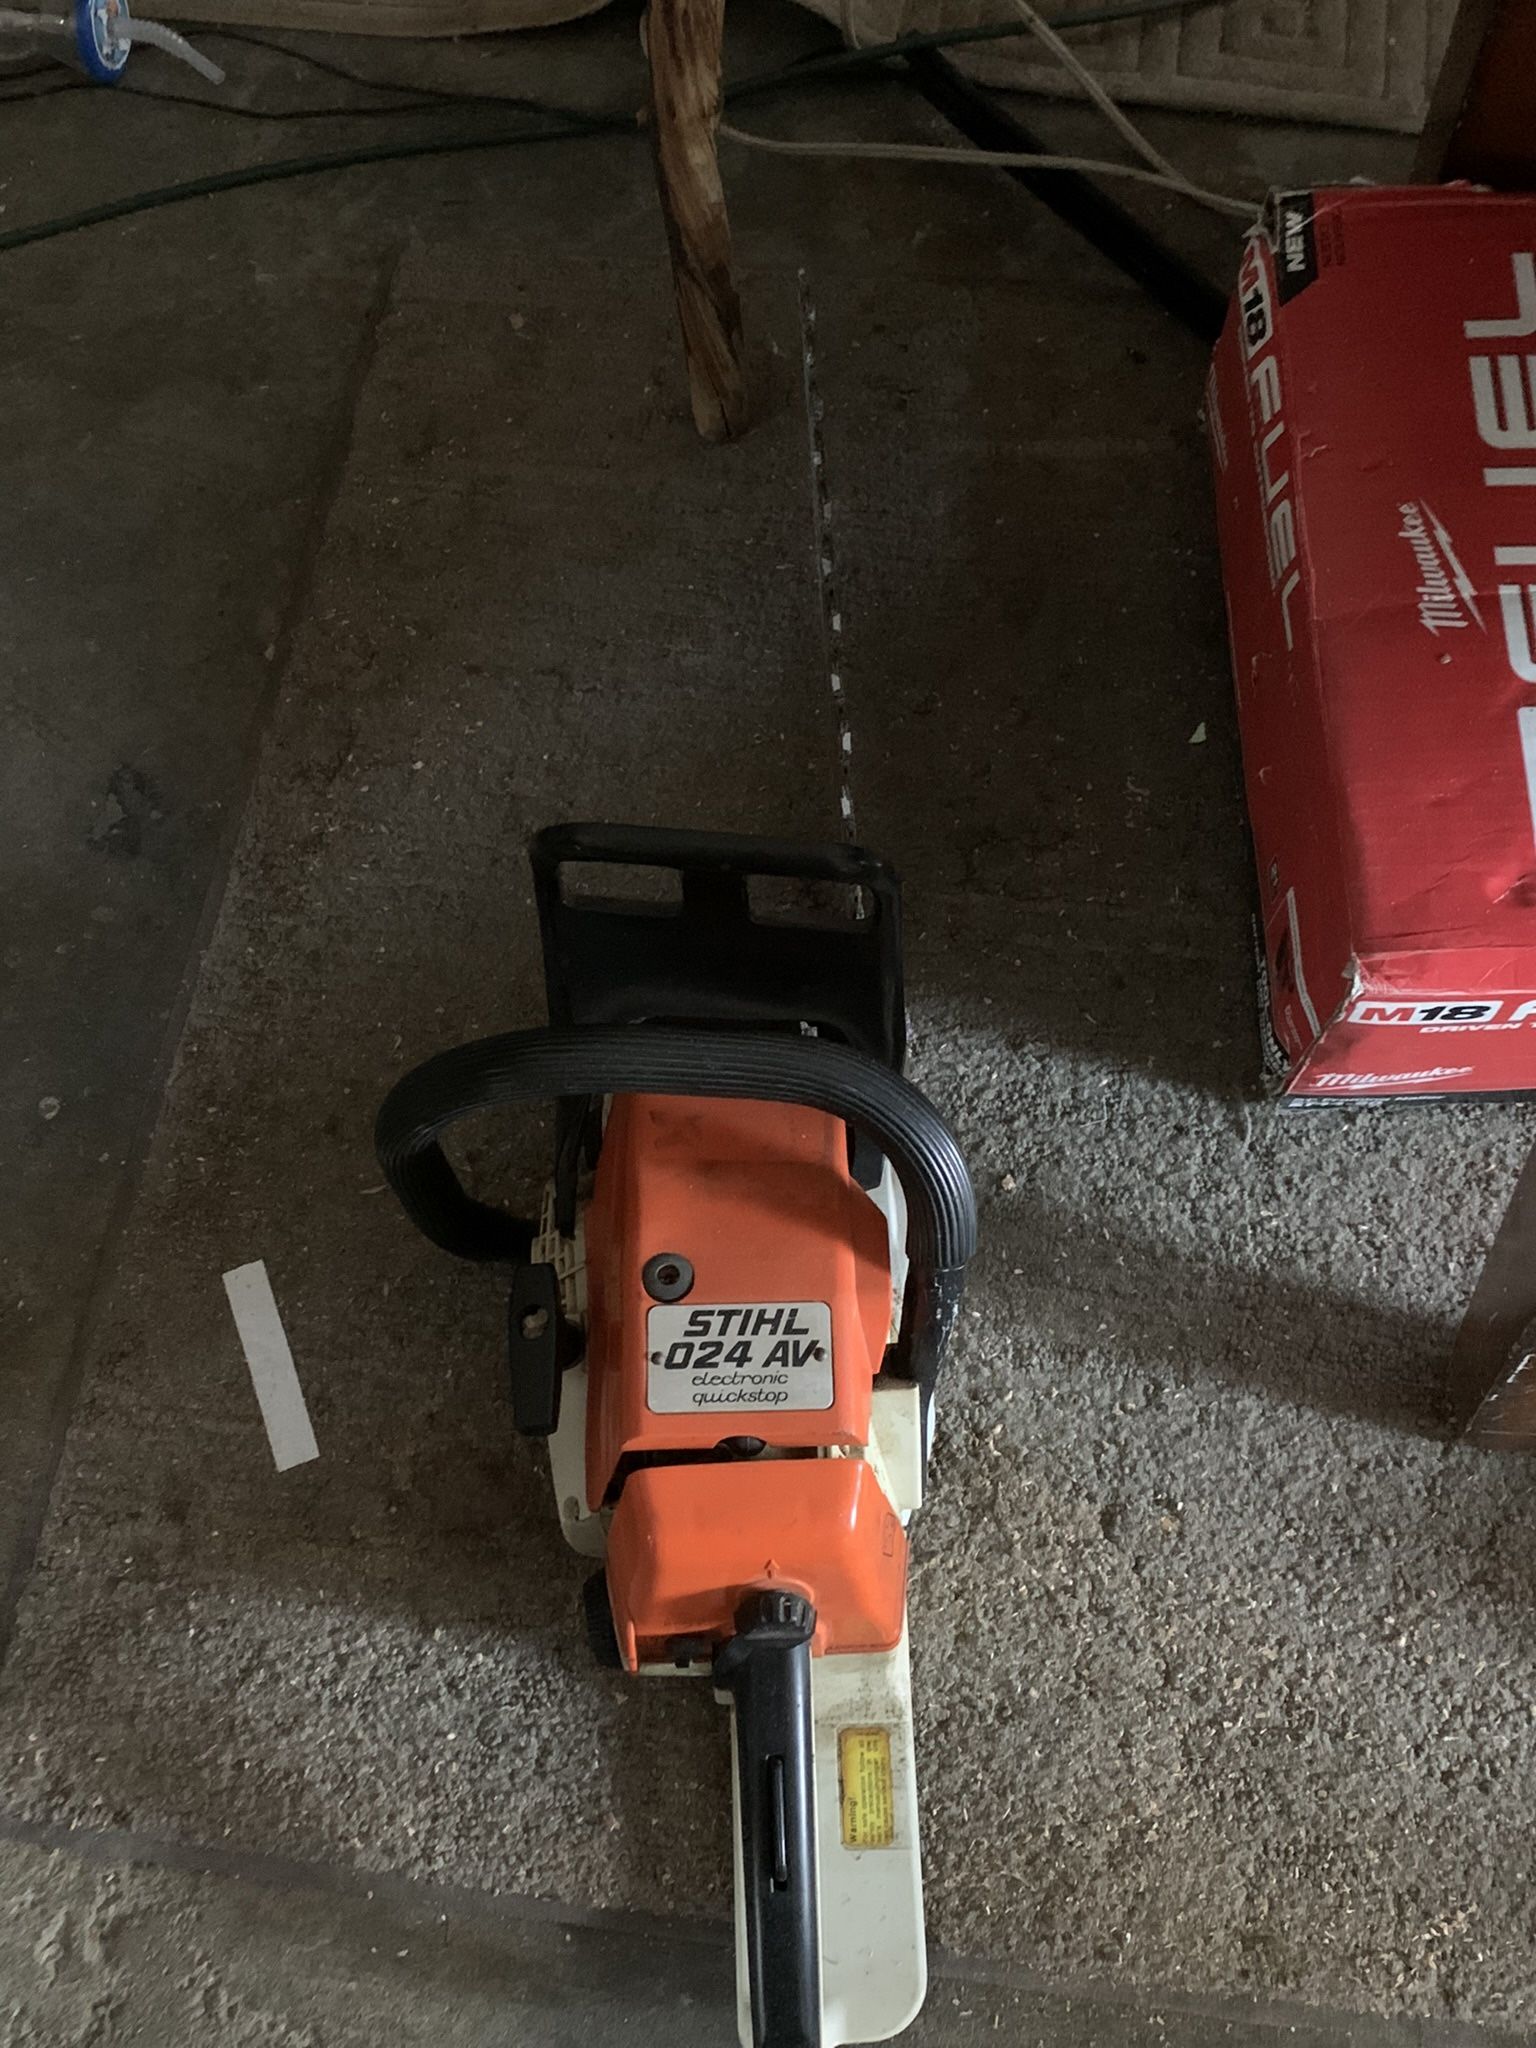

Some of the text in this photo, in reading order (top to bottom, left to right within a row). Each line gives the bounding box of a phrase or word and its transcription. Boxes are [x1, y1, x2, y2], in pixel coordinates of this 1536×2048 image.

[1284, 209, 1306, 273] NEW
[1250, 355, 1300, 651] FUEL
[1398, 501, 1469, 637] Milwaukee
[1359, 1004, 1492, 1022] M18
[1419, 1022, 1522, 1034] DRIVEN
[1310, 1066, 1475, 1088] Milwaukee
[683, 1307, 810, 1338] STIHL
[664, 1339, 820, 1370] 024 AV
[691, 1370, 789, 1387] electronic
[691, 1388, 789, 1407] quickstop
[849, 1797, 859, 1843] Warning!
